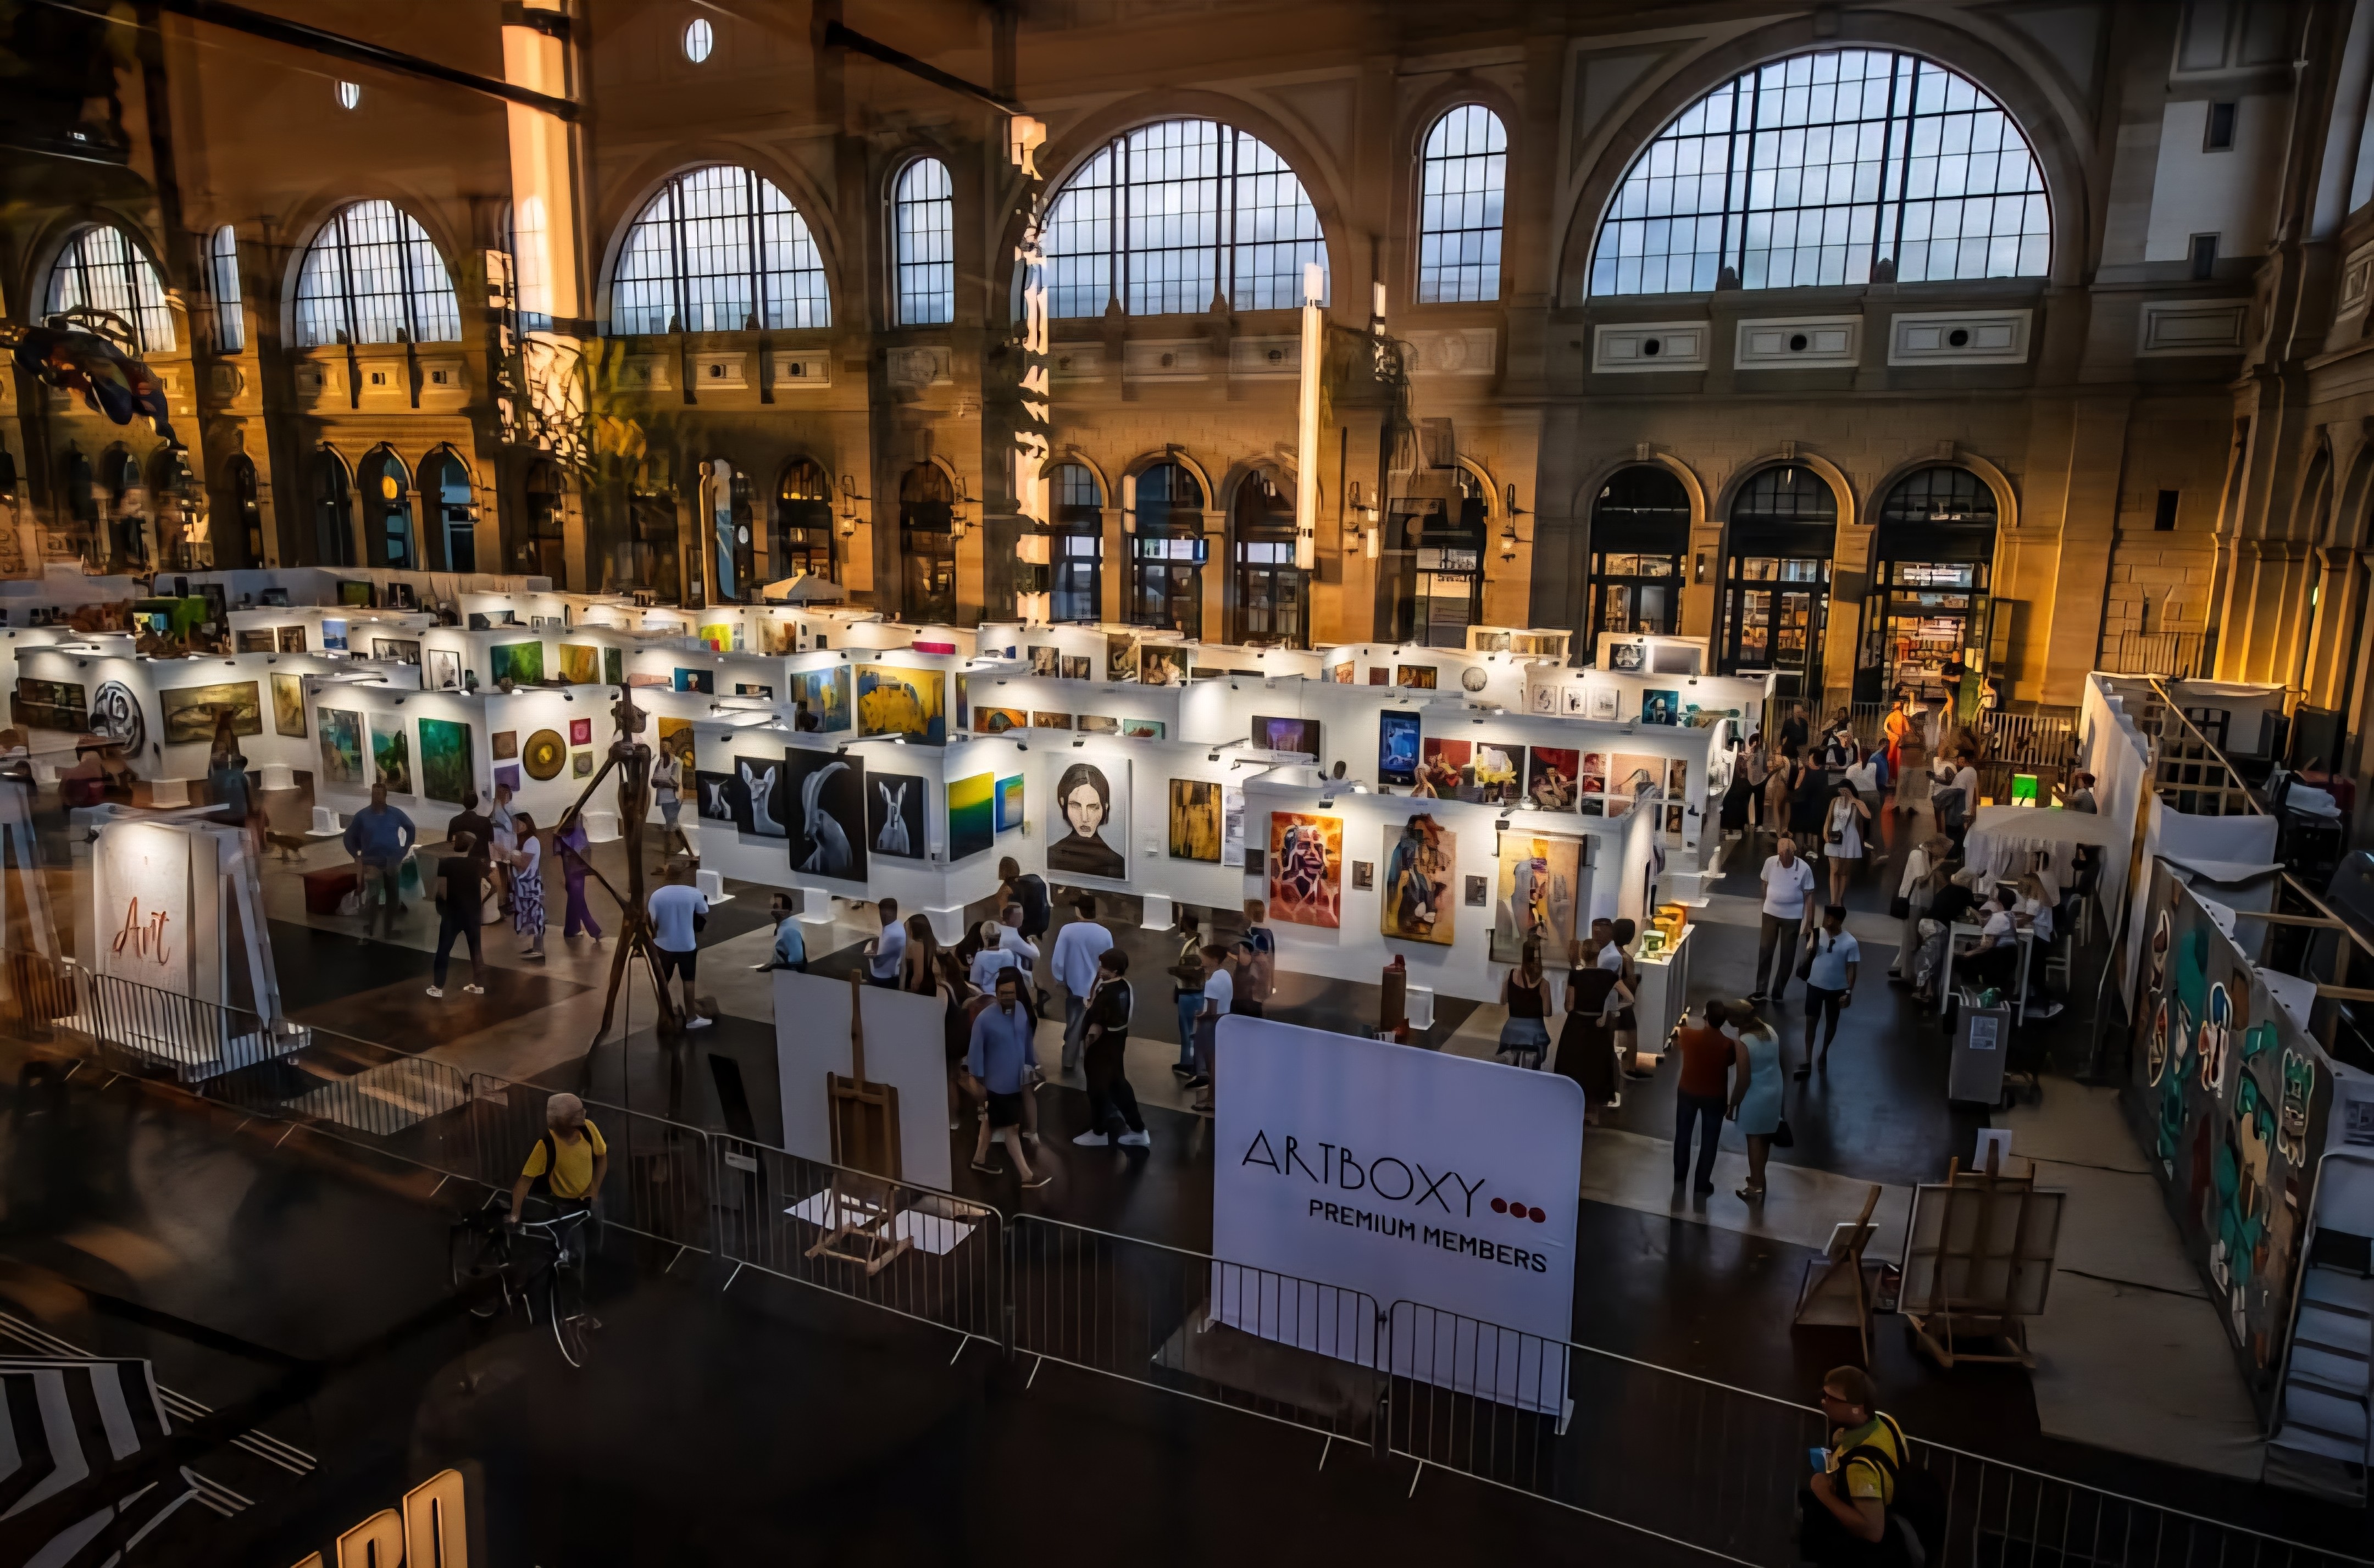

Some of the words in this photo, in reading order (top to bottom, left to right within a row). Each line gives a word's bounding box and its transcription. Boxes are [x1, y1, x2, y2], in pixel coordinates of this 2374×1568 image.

[112, 896, 170, 966] Art
[1241, 1129, 1485, 1218] ARTBOXY
[1310, 1199, 1416, 1241] PREMIUM
[1423, 1225, 1547, 1274] MEMBERS
